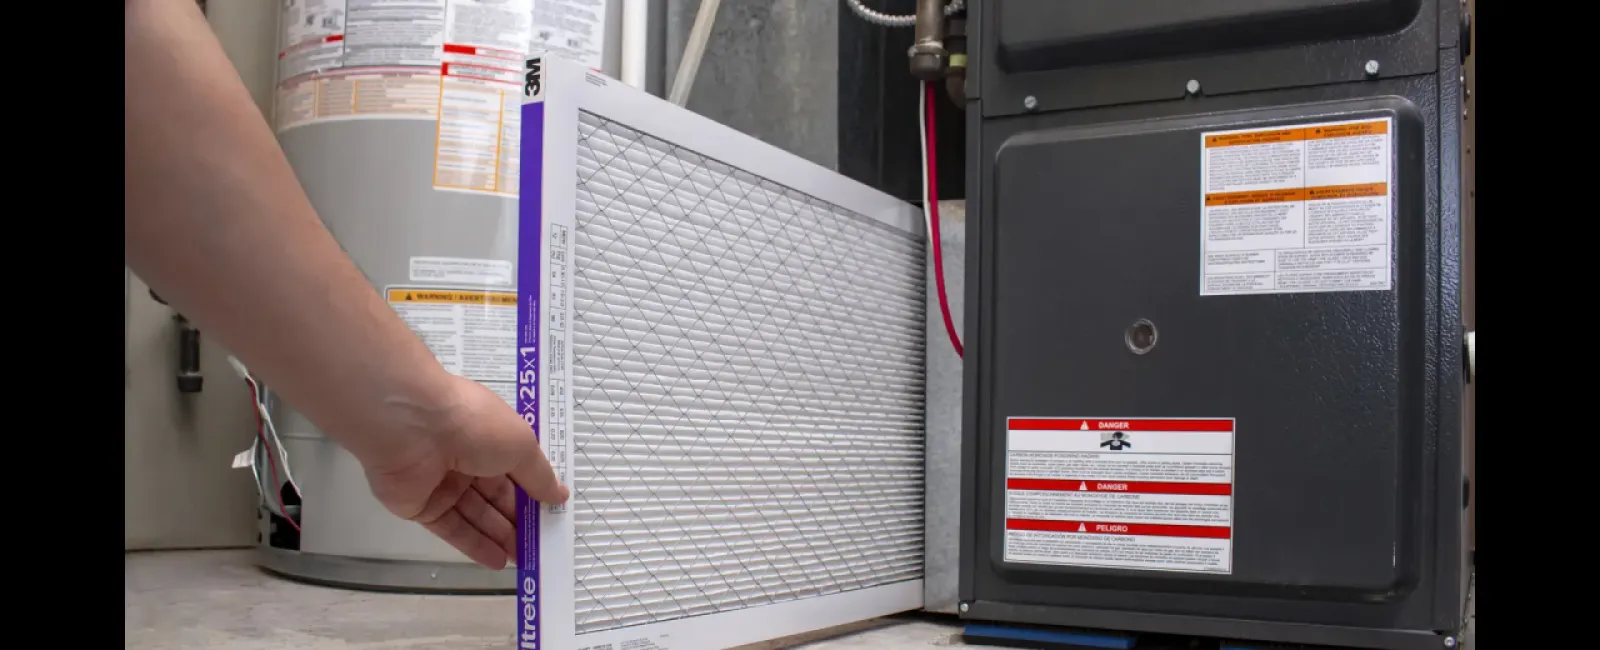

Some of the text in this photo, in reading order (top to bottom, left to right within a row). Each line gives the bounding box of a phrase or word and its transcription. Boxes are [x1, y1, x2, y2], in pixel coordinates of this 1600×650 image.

[525, 57, 541, 97] 3M
[519, 347, 536, 429] 6x25x1
[1098, 421, 1129, 429] DANGER
[1097, 483, 1128, 491] DANGER
[1096, 524, 1128, 532] PELIGRO
[520, 577, 536, 650] ltrete
